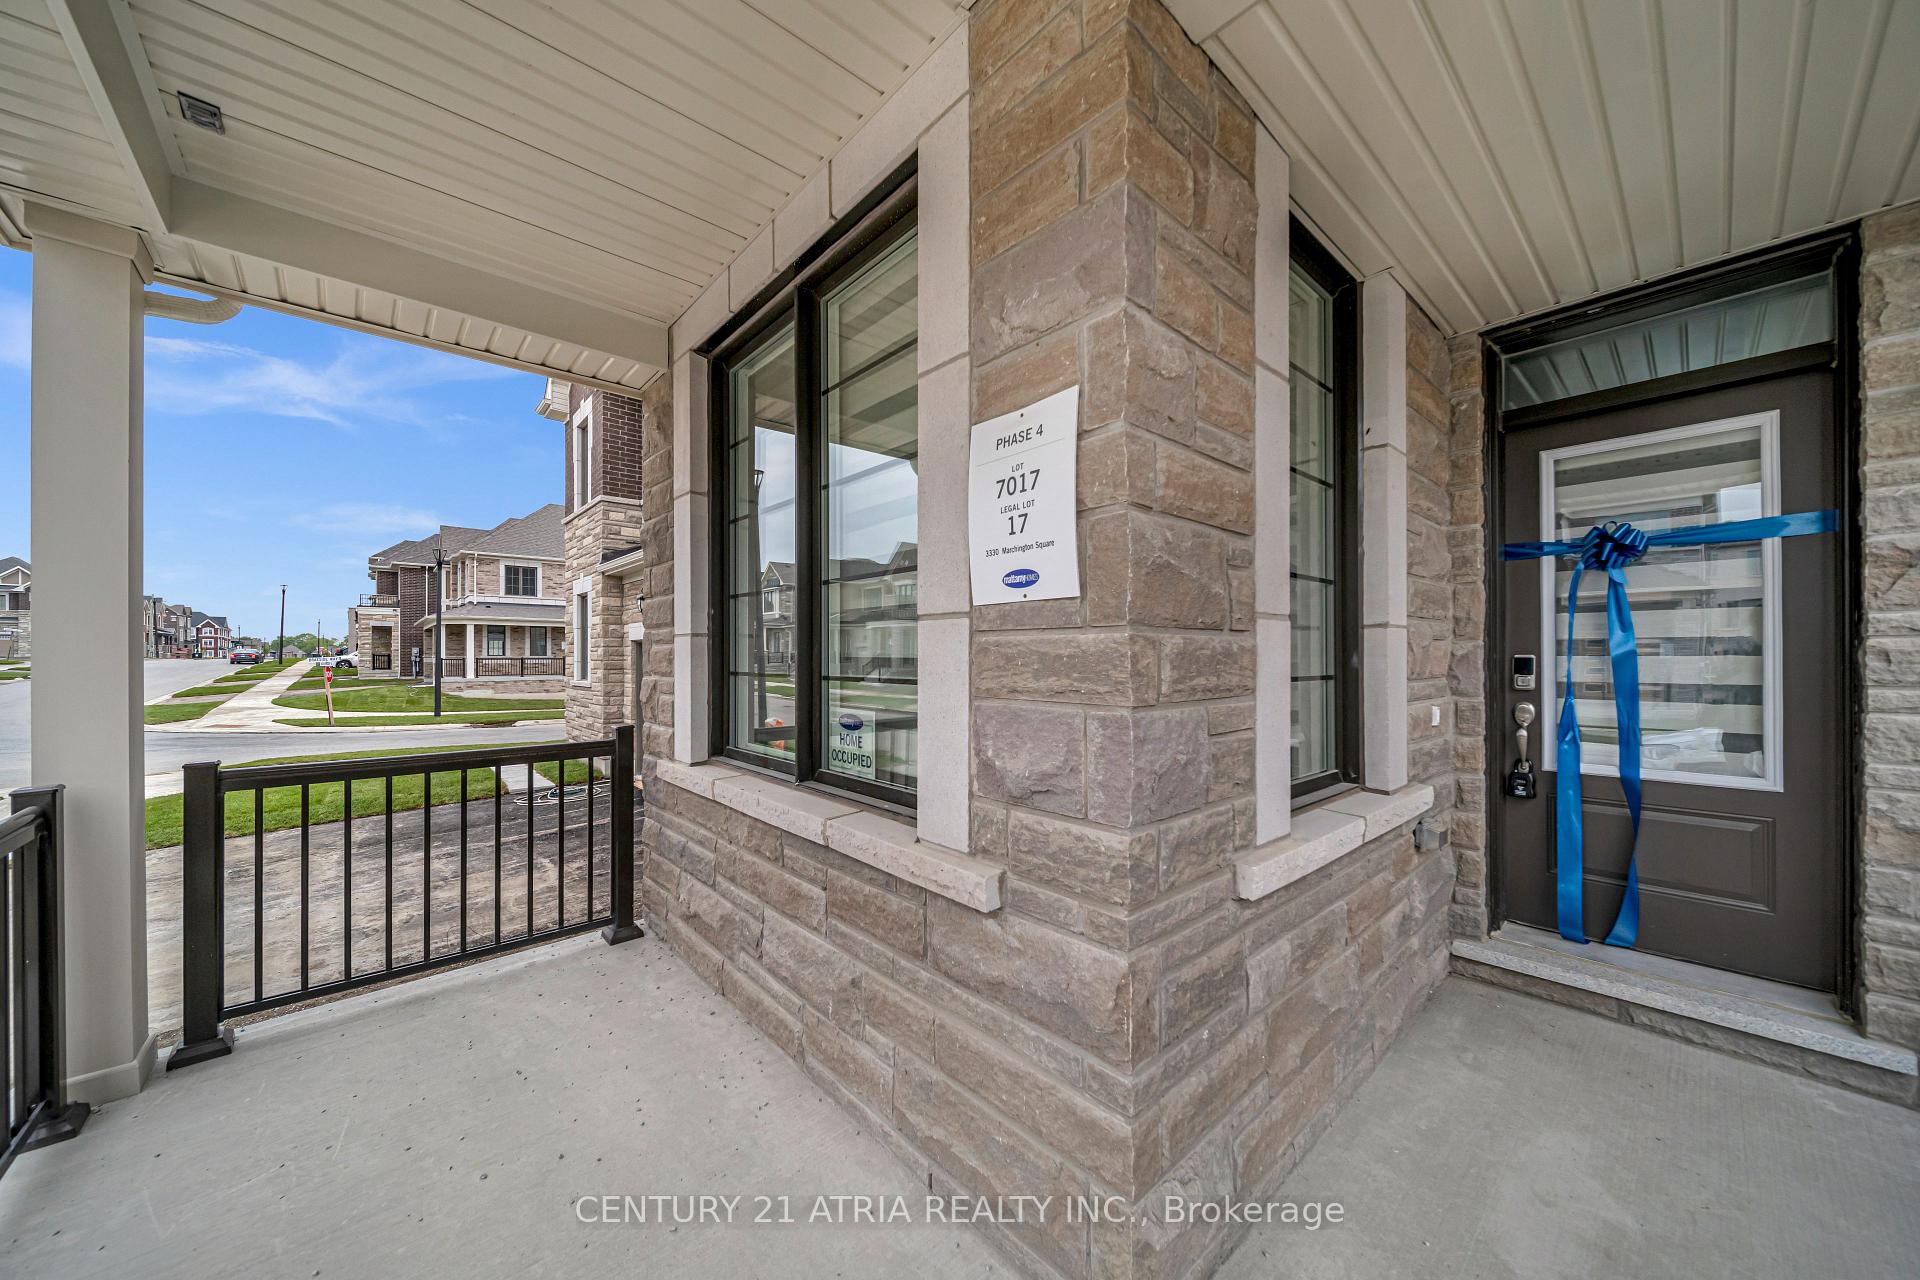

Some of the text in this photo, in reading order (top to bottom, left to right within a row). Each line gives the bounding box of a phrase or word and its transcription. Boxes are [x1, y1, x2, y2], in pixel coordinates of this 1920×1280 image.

[996, 424, 1044, 450] PHASE 4
[1011, 462, 1024, 473] LOT
[996, 469, 1040, 499] 7017
[1000, 499, 1035, 514] LEGAL LOT
[1008, 513, 1028, 536] 17
[1001, 543, 1034, 555] Marchington
[1035, 540, 1055, 549] Square
[839, 733, 863, 749] HOME
[831, 749, 872, 768] OCCUPIED
